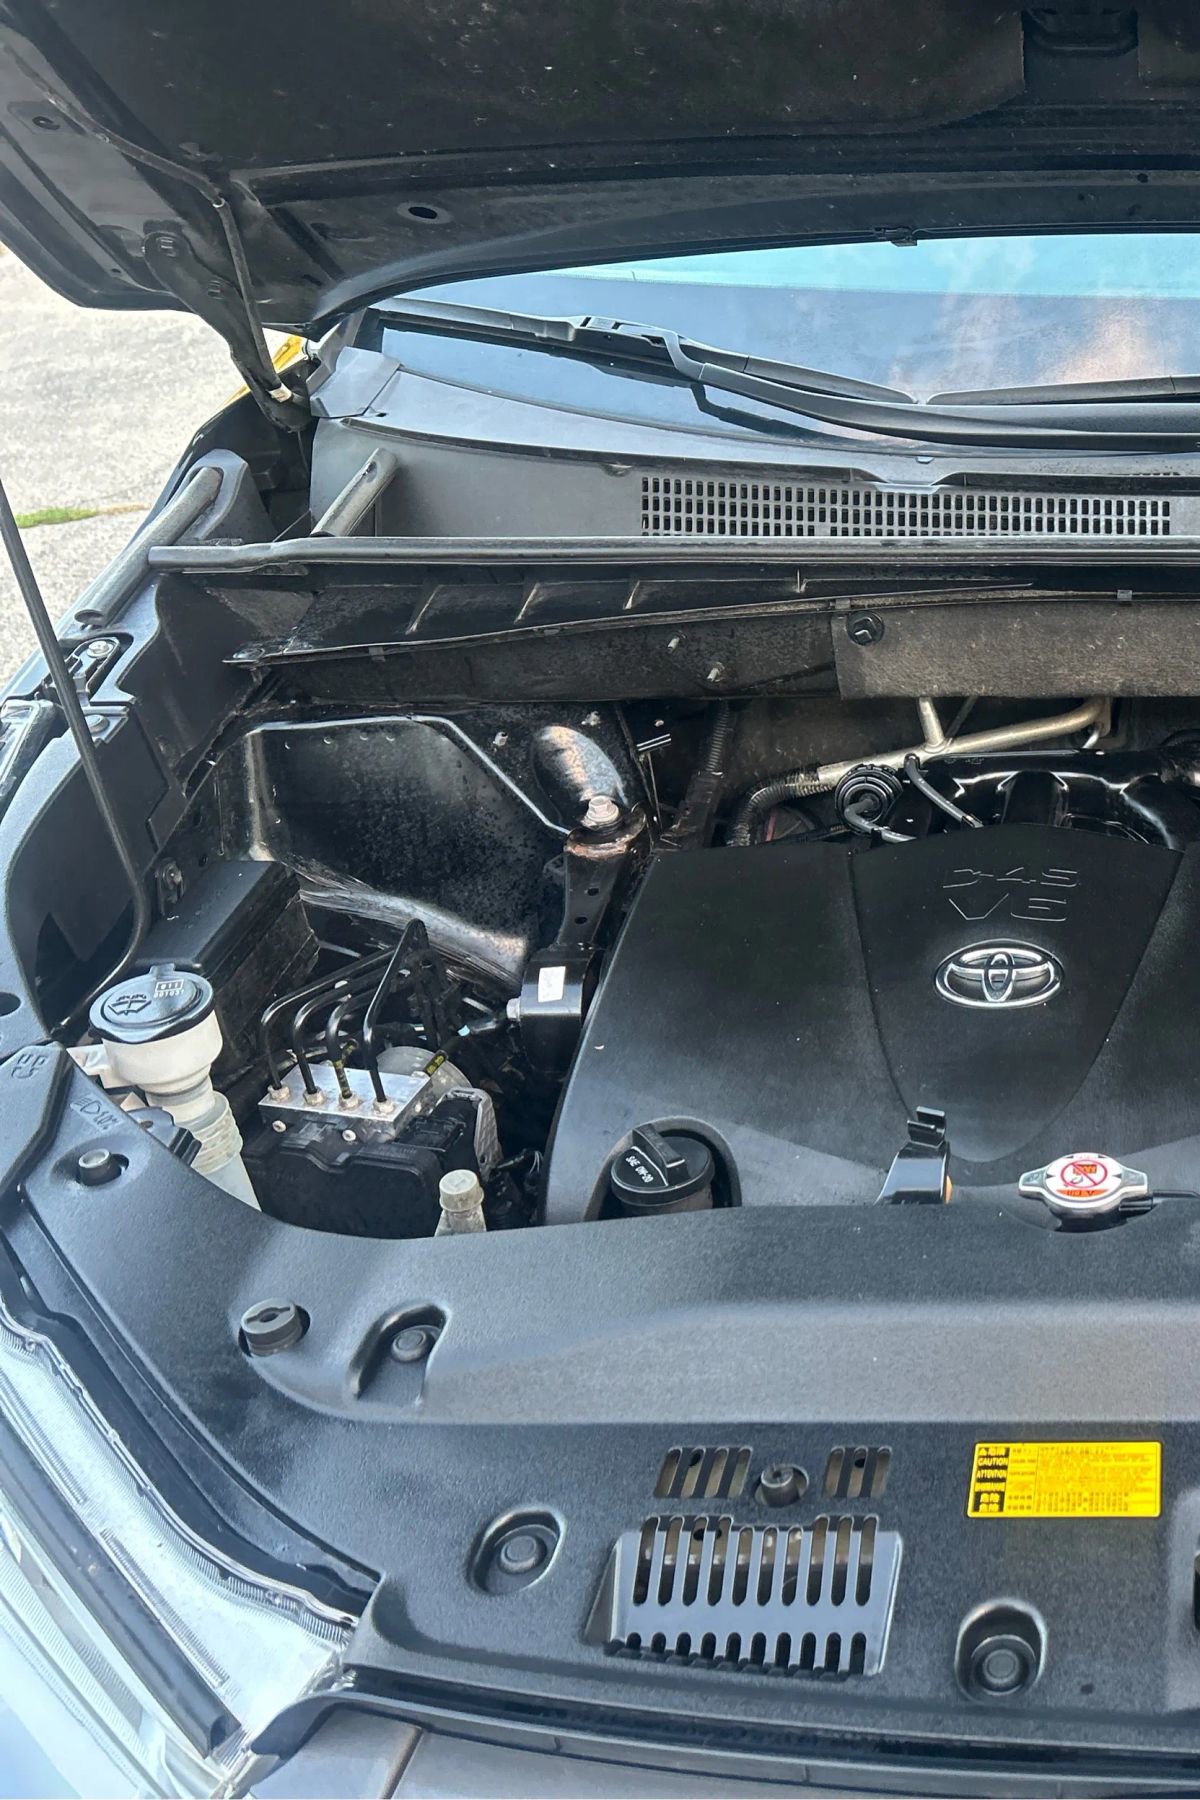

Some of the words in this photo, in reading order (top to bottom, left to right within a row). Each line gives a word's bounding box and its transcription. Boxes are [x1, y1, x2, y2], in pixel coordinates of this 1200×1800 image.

[948, 893, 1068, 922] V6
[625, 1155, 641, 1167] SAE
[978, 1457, 1009, 1466] CAUTION
[976, 1469, 1007, 1478] ATTENTION
